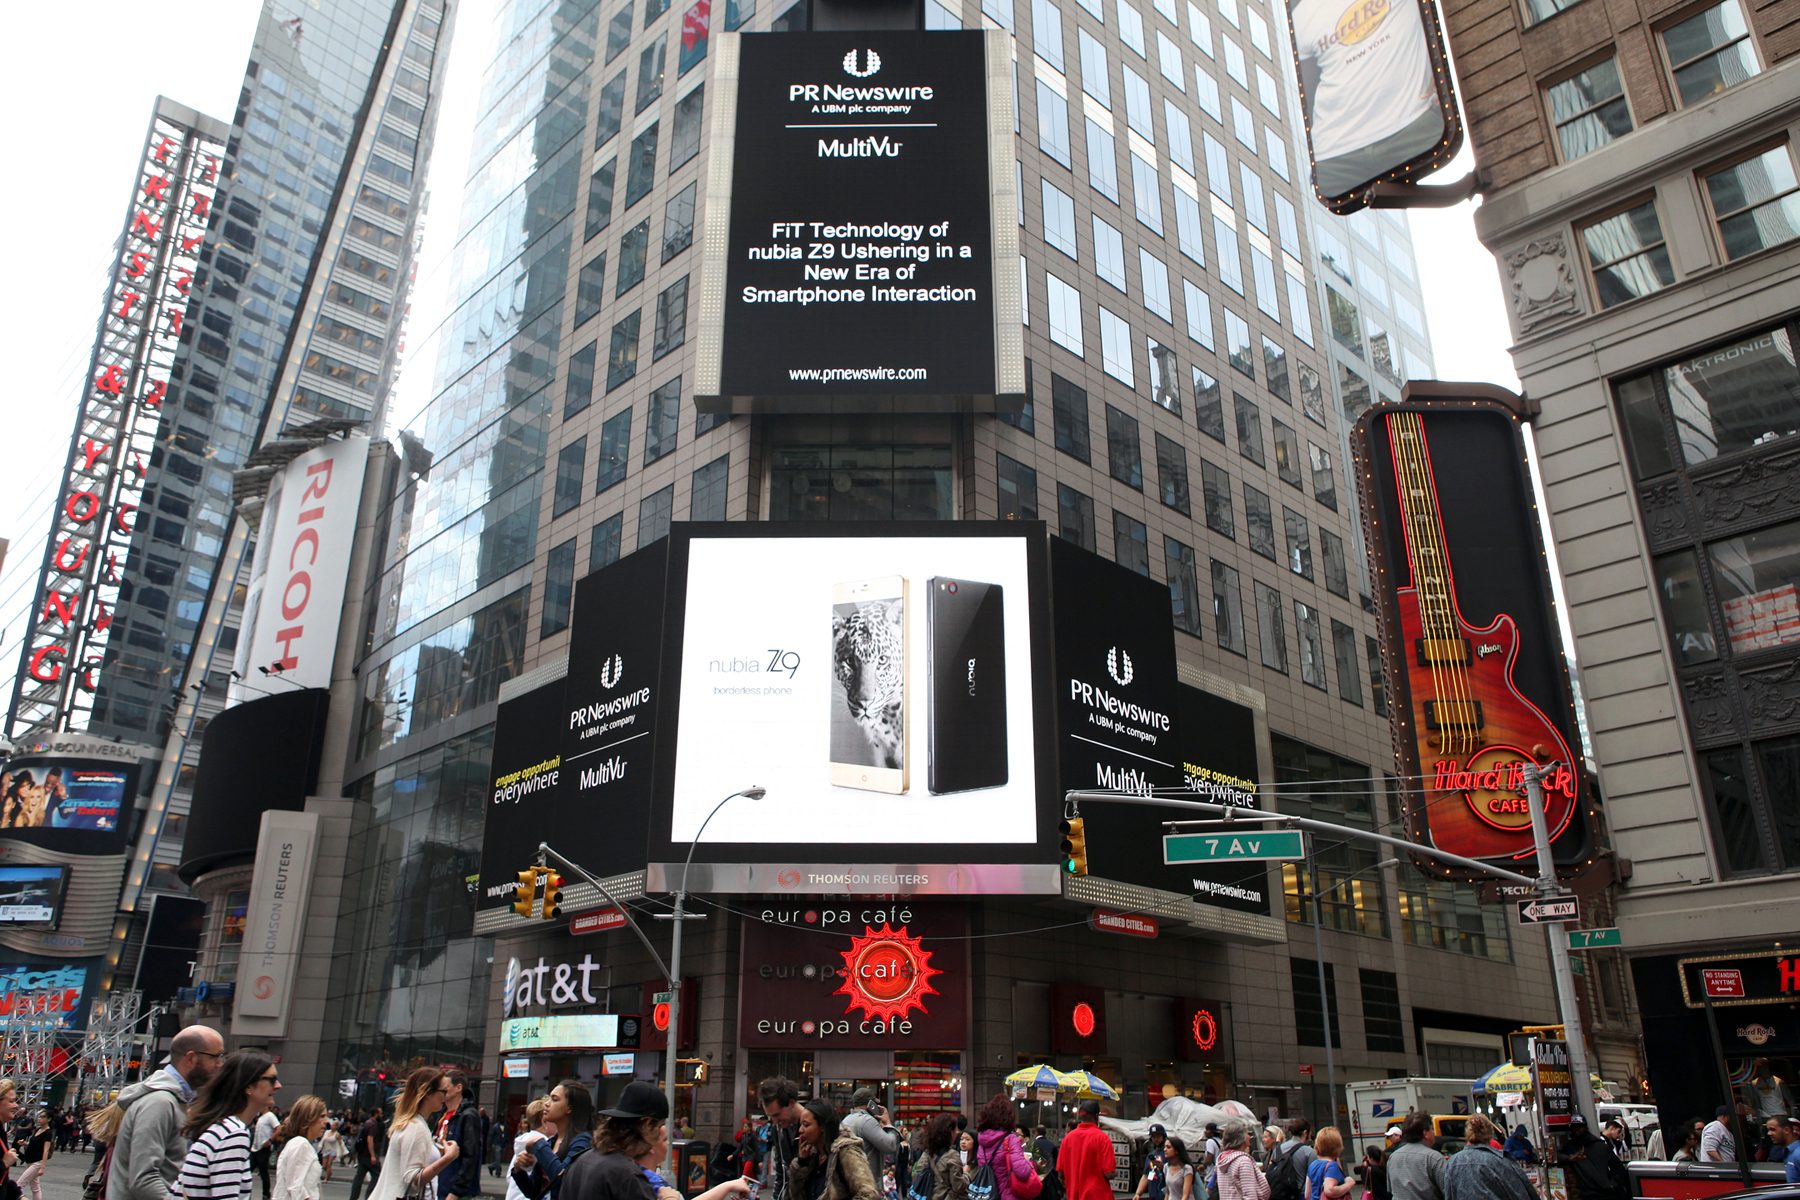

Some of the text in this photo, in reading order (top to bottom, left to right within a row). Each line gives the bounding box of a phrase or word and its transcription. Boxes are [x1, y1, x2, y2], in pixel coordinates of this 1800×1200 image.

[1345, 34, 1391, 65] NEW YORK
[789, 84, 933, 101] PR Newswire
[811, 104, 911, 115] A UBM plc company
[116, 136, 177, 319] ERNST
[772, 221, 949, 241] FiT Technology of
[749, 242, 972, 262] nubia Z9 Ushering in a
[804, 264, 917, 281] New Era of
[742, 285, 977, 306] Smartphone Interaction
[95, 364, 126, 396] &
[789, 366, 928, 384] www.prnewswire.com
[30, 438, 110, 682] YOUNG
[271, 458, 334, 673] RICOH
[709, 649, 801, 680] nubia Z9
[713, 686, 793, 696] borderless phone
[570, 687, 650, 730] PR Newswire
[1071, 679, 1170, 732] PR Newswire
[580, 714, 636, 740] A UBM plc company
[1088, 713, 1157, 746] A UBM plc company
[494, 770, 559, 804] everywhere
[495, 770, 522, 788] engage
[1212, 771, 1257, 794] opportunity
[1434, 760, 1574, 798] Hard Rck
[1489, 800, 1529, 813] CAFE
[1205, 838, 1261, 856] 7 Av
[808, 874, 929, 885] THOMSON REUTERS
[1193, 878, 1262, 902] www.prnewswire.com
[261, 842, 293, 968] THOMSON REUTERS
[1529, 904, 1572, 917] ONE WAY
[761, 906, 913, 928] europa café
[1581, 931, 1606, 946] 7 AV
[860, 959, 913, 979] café
[516, 953, 600, 1009] at&t
[523, 1026, 540, 1039] at&t
[757, 1015, 913, 1039] europa café
[1488, 1083, 1530, 1091] SABRETT
